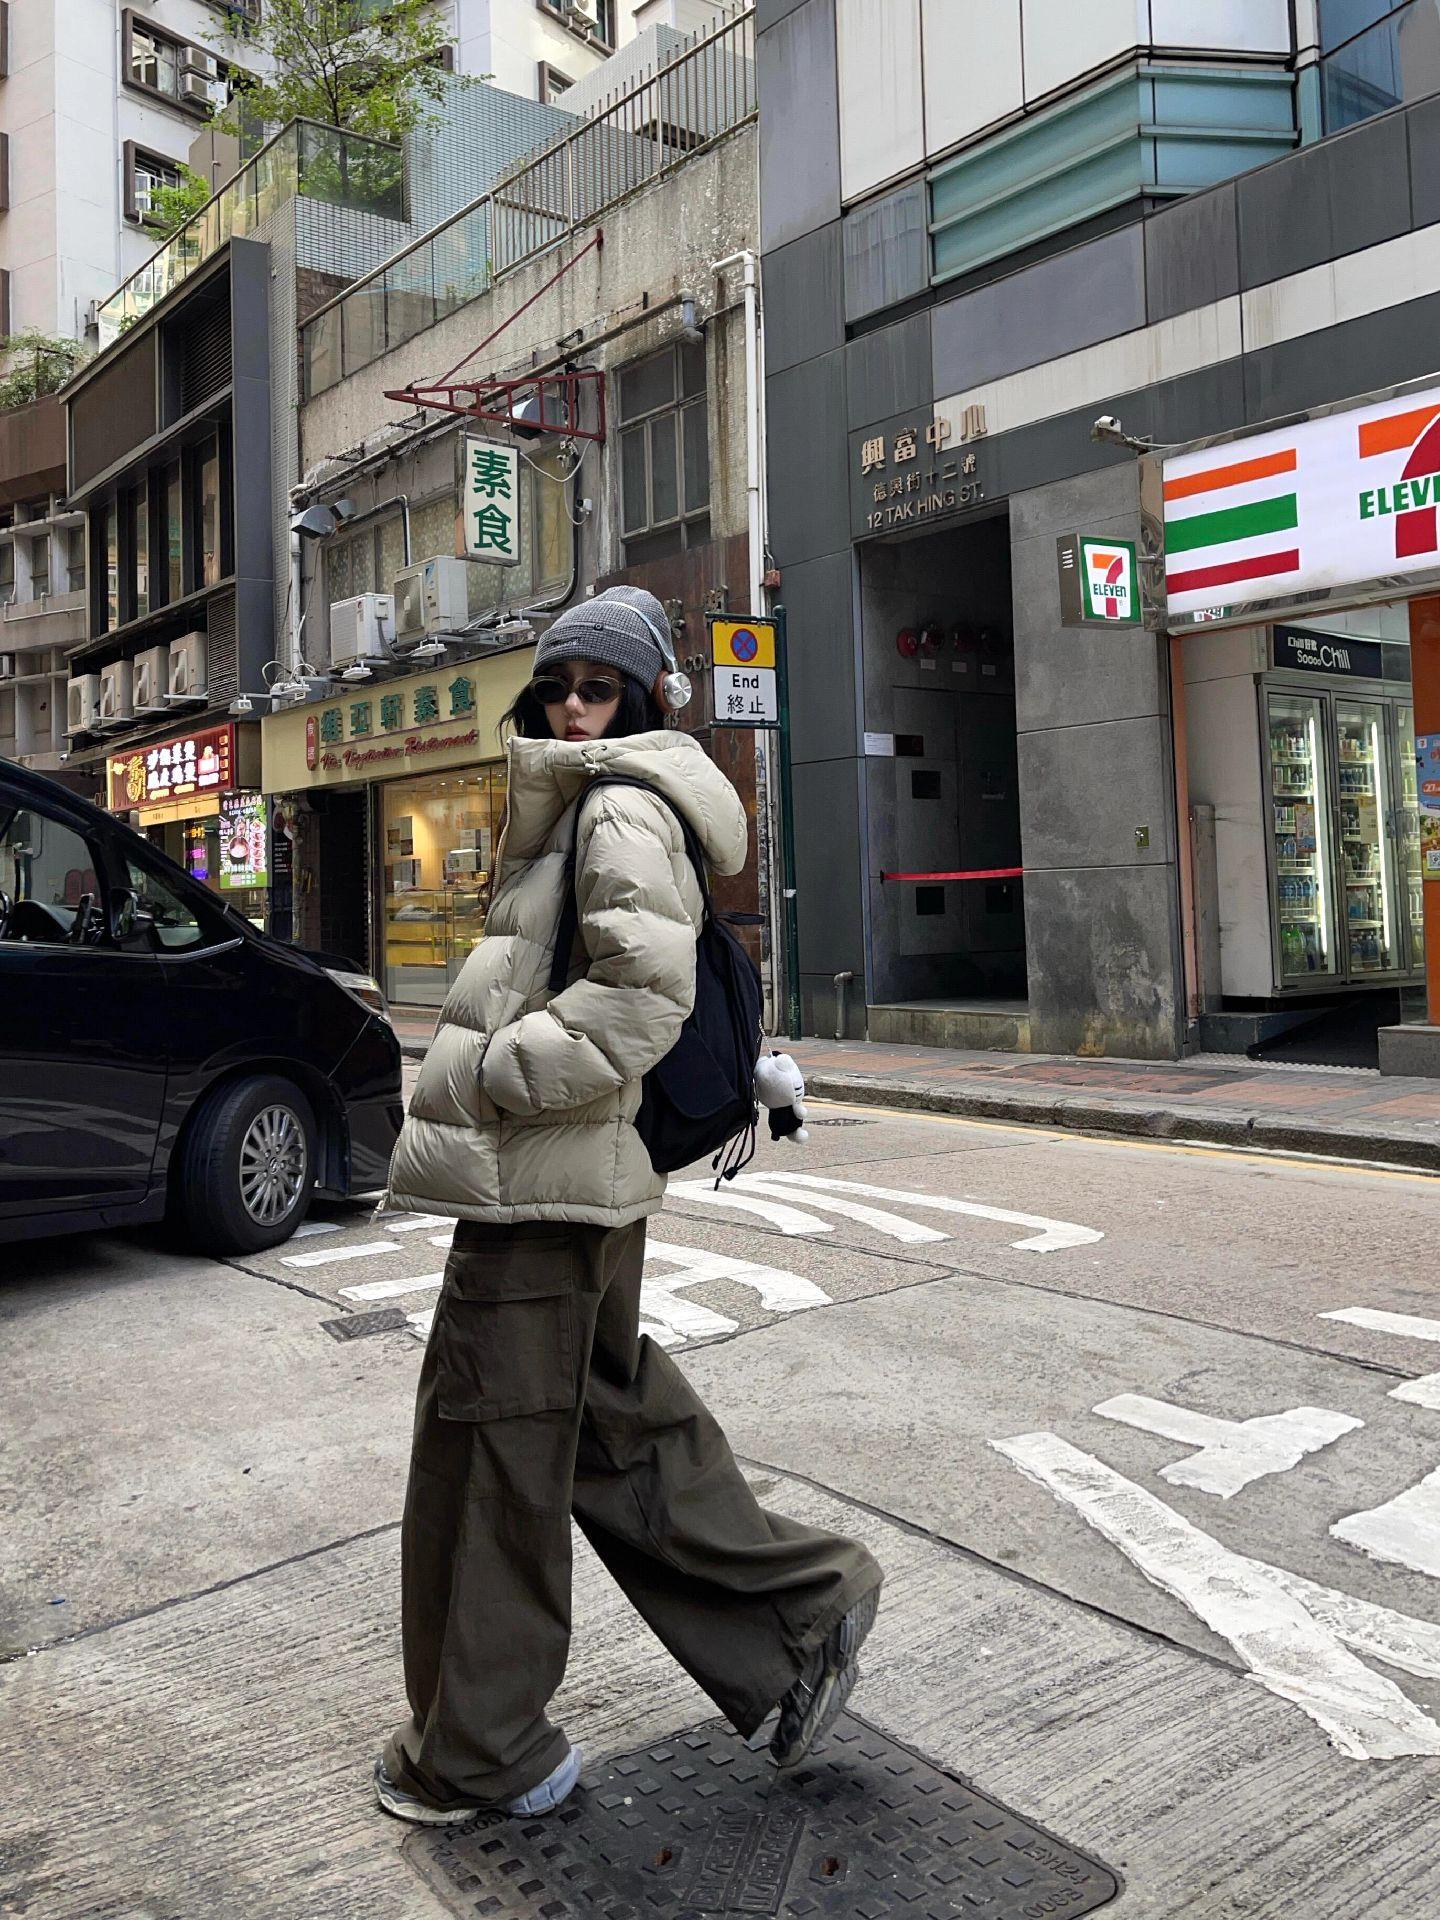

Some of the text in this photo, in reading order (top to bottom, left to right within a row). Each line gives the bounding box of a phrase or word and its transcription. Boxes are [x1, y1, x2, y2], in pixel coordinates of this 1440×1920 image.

[861, 404, 988, 475] 興富中心
[471, 447, 513, 556] 素食
[867, 481, 985, 529] 12 TAK HING ST.
[1320, 645, 1351, 670] Chill
[732, 673, 760, 689] End
[726, 693, 766, 715] 終止
